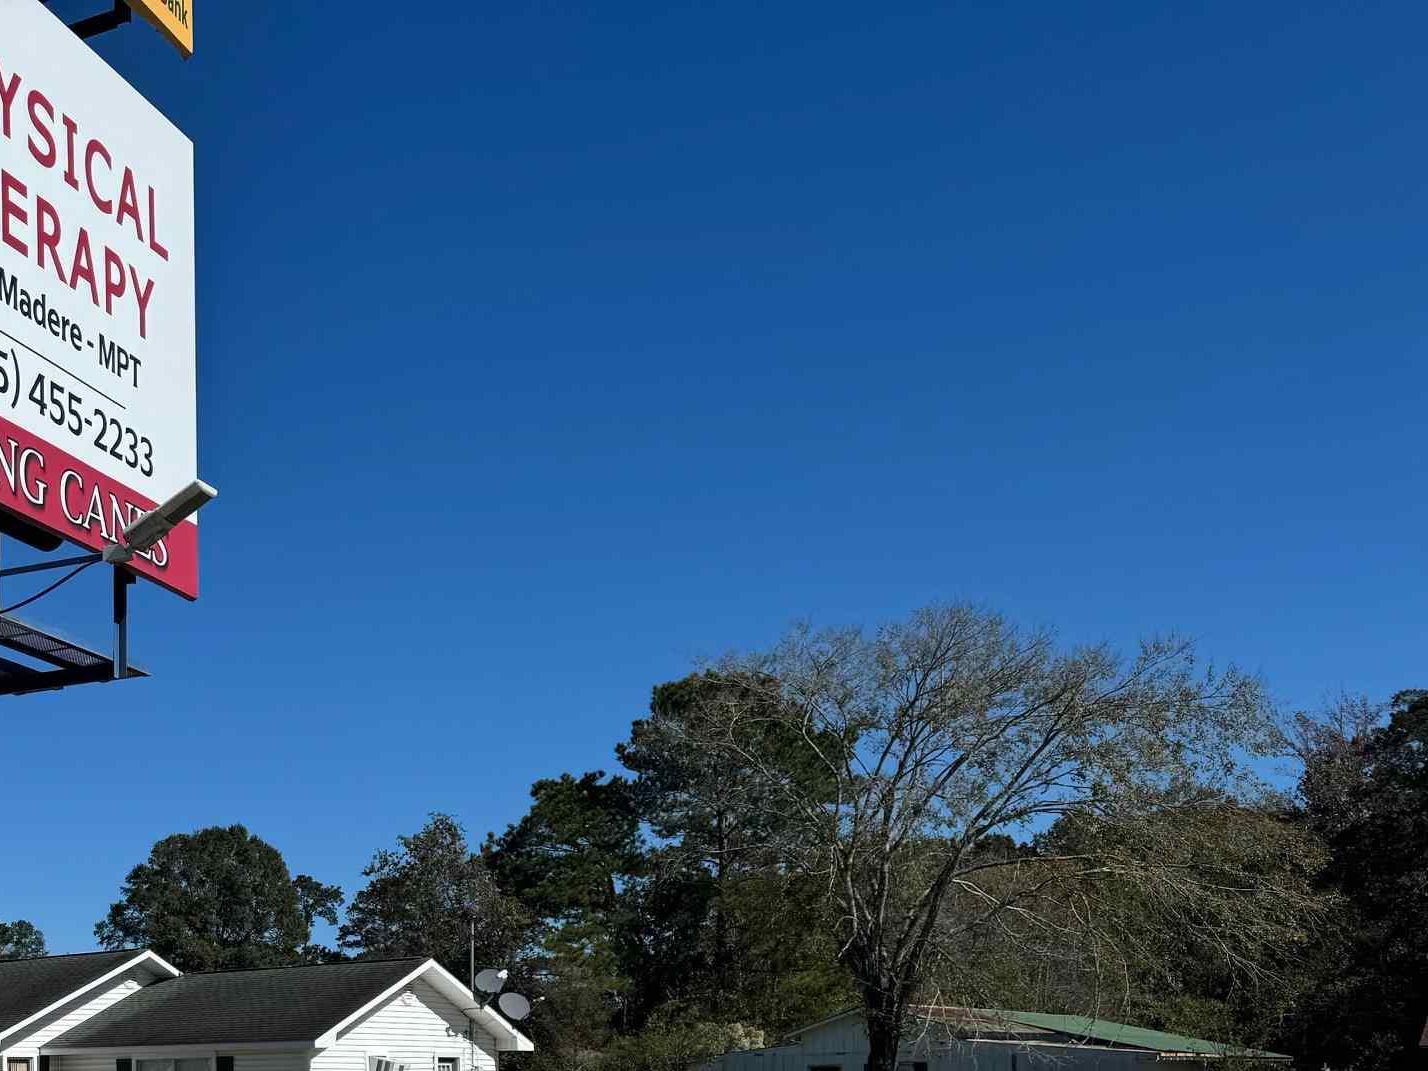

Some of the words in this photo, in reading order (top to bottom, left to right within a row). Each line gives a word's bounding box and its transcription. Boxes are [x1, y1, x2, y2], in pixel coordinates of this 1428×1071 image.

[160, 0, 189, 29] ank
[99, 333, 142, 388] MPT
[28, 373, 153, 477] 455-2233
